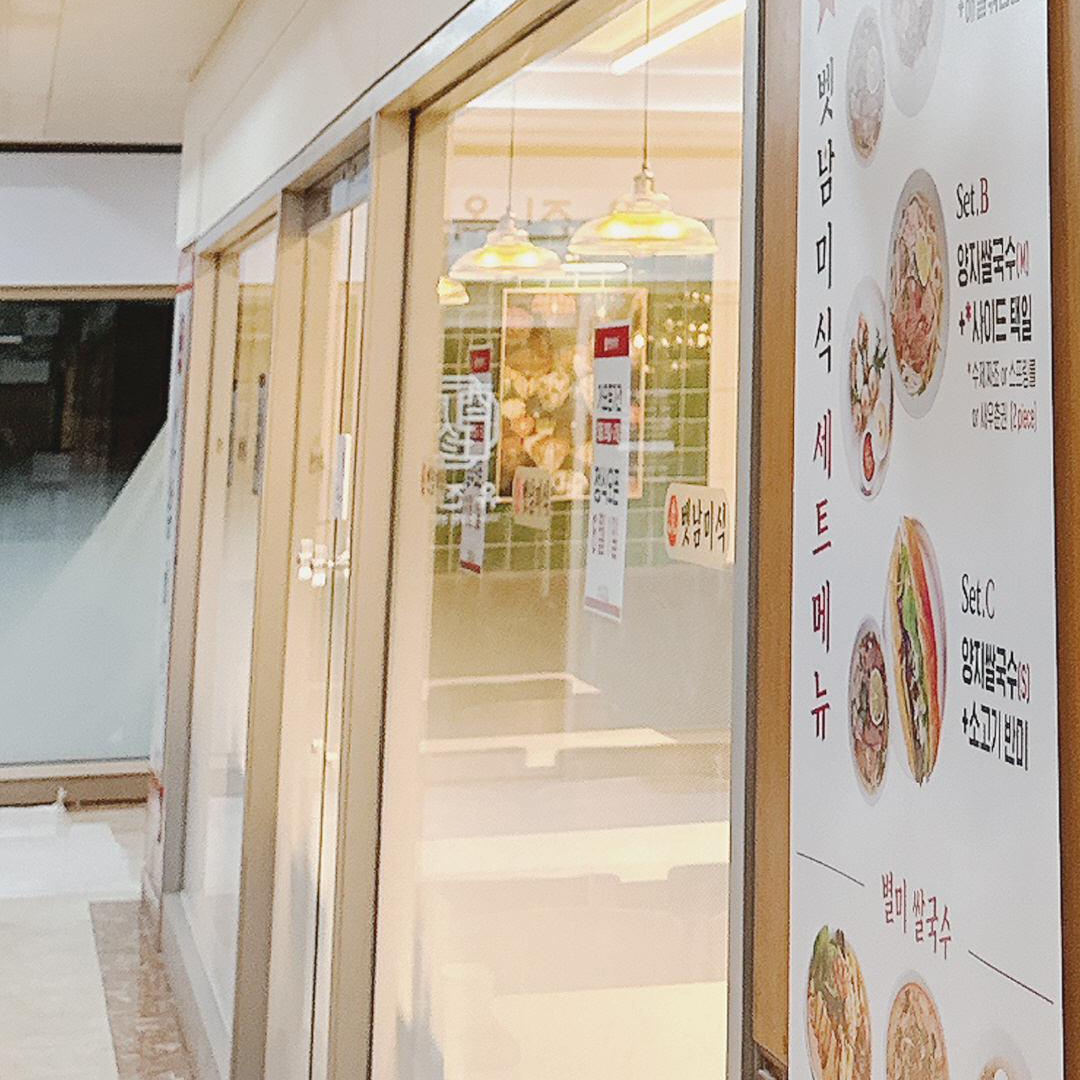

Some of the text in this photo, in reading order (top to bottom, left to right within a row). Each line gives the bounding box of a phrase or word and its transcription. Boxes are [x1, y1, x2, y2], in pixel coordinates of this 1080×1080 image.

[956, 177, 989, 220] Set.B
[1010, 294, 1032, 343] 택일
[811, 56, 835, 741] 벳남미식 세트메뉴
[681, 497, 726, 553] 벳남미식
[962, 573, 995, 620] Set.C
[1004, 713, 1028, 771] 반미
[882, 871, 951, 960] 별미 쌀국수
